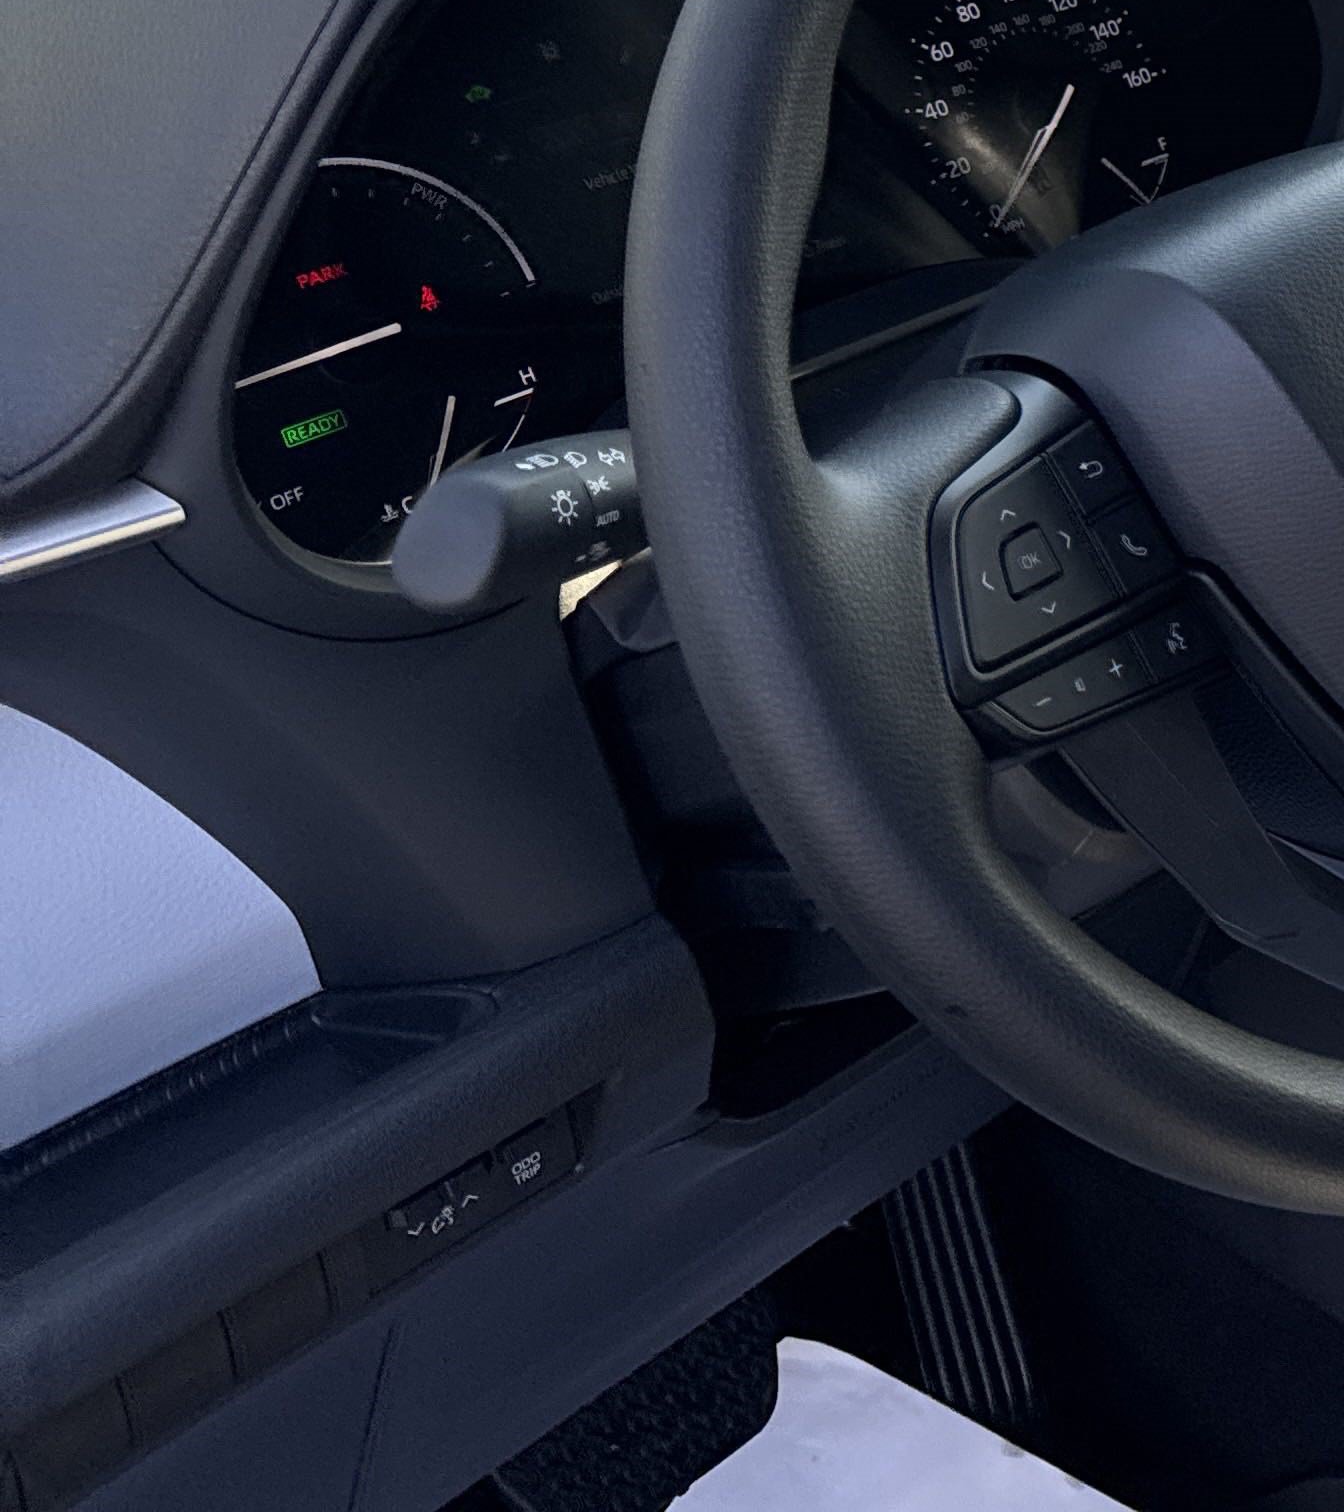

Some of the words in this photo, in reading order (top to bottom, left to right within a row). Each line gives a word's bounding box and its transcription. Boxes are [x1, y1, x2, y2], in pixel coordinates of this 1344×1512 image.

[955, 2, 980, 23] 80
[1090, 19, 1119, 41] 140
[929, 41, 954, 62] 60
[1122, 66, 1152, 88] 160
[924, 99, 949, 120] 40
[1156, 136, 1167, 152] F
[946, 156, 971, 178] 20
[583, 167, 629, 193] Vehicle
[412, 182, 448, 210] PWR
[989, 204, 1002, 220] 0
[296, 263, 348, 289] PARK
[518, 366, 538, 386] H
[287, 413, 341, 444] READY
[270, 486, 305, 511] OFF
[597, 509, 620, 527] AUTO
[1017, 550, 1043, 571] OK
[511, 1150, 542, 1175] ODO
[513, 1162, 542, 1186] TRIP
